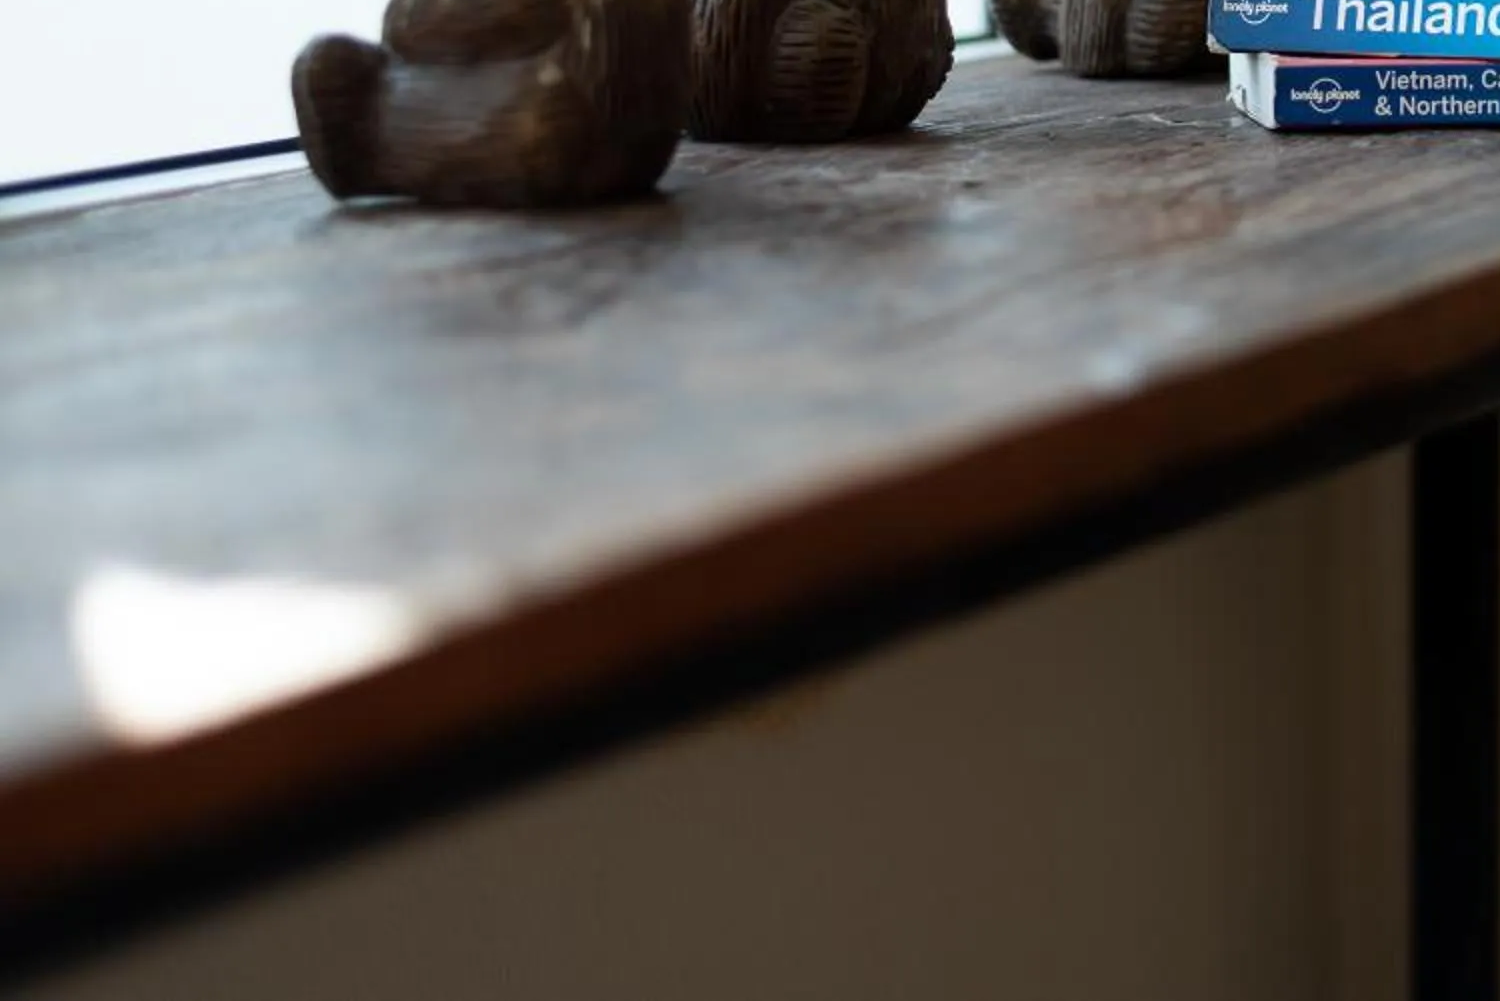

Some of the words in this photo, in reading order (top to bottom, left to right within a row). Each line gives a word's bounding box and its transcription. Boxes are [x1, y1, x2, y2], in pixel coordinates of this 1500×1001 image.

[1222, 0, 1253, 15] lonely
[1255, 0, 1289, 15] planet
[1375, 70, 1474, 92] Vietnam,
[1290, 87, 1323, 103] lonely
[1325, 87, 1361, 103] planet
[1375, 97, 1393, 116] &
[1399, 95, 1500, 117] Northern
